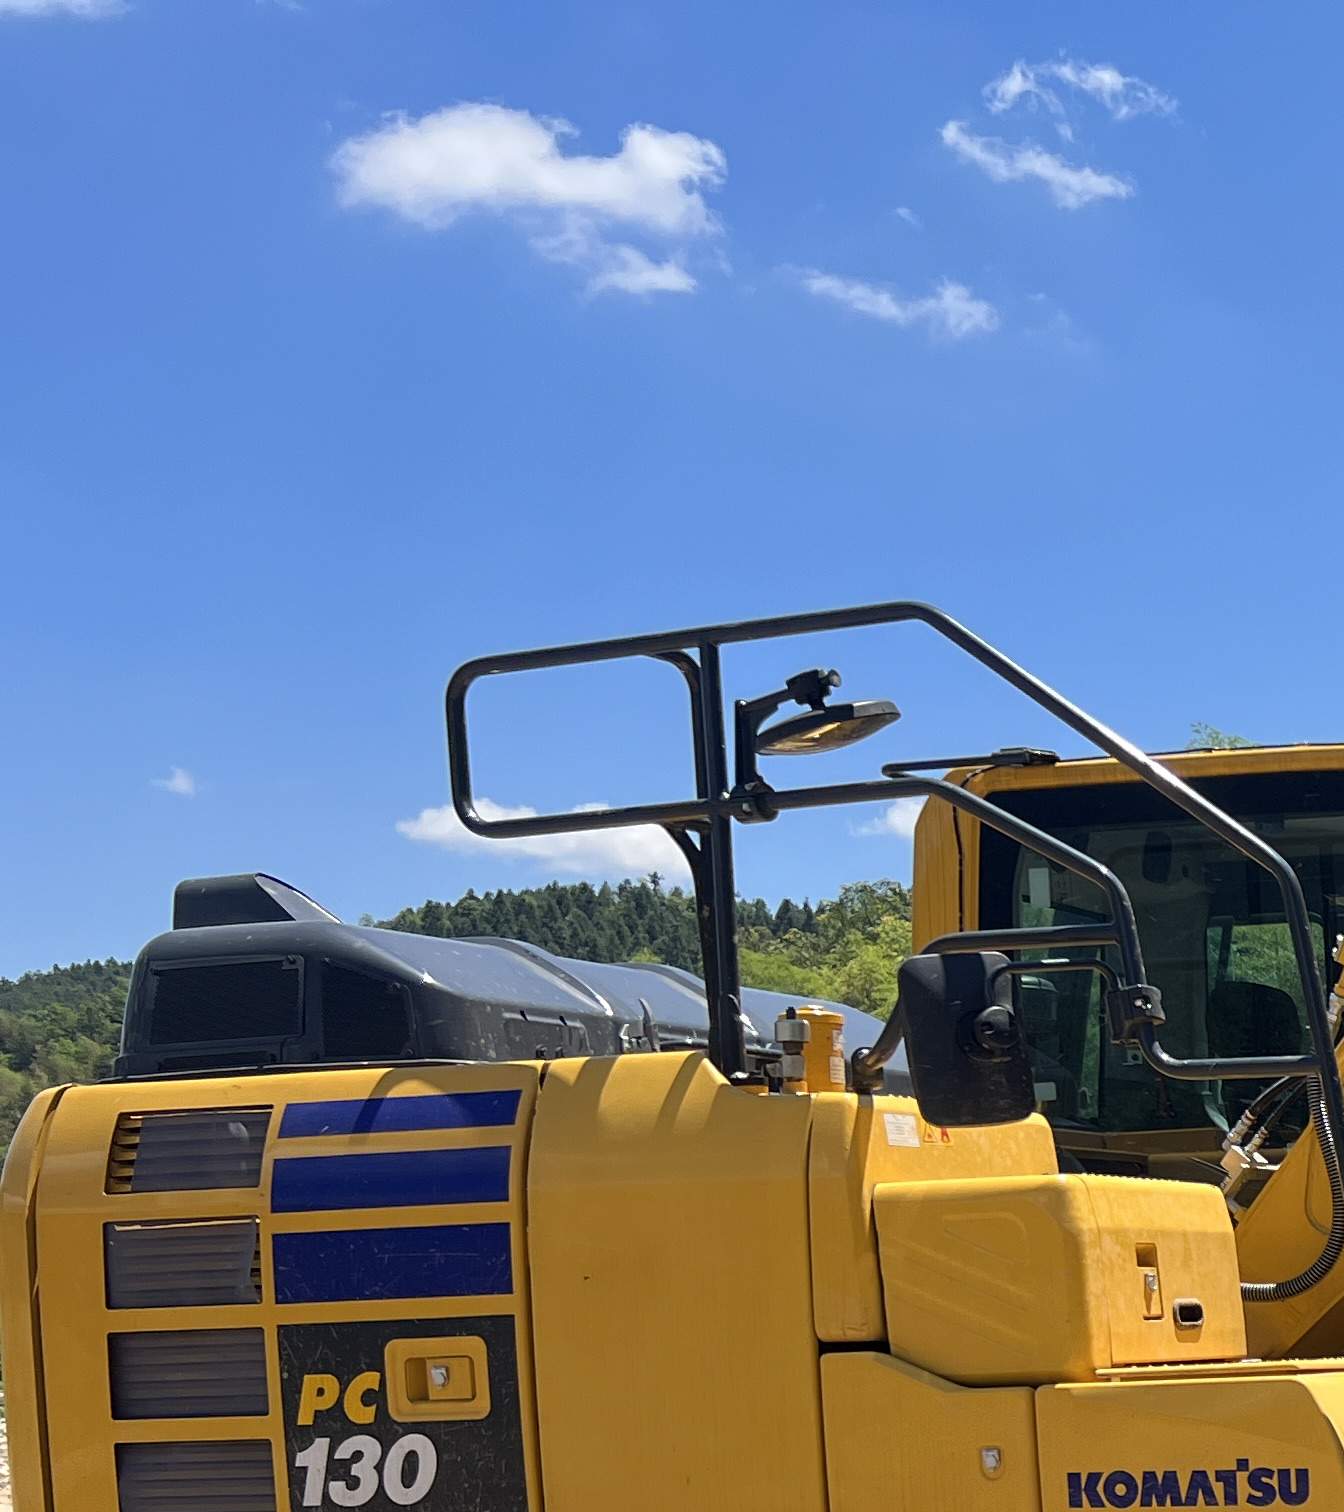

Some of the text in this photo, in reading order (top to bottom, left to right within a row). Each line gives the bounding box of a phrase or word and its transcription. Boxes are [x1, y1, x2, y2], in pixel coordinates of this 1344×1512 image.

[296, 1371, 381, 1426] PC
[294, 1433, 438, 1507] 130
[1066, 1458, 1310, 1509] KOMATSU
